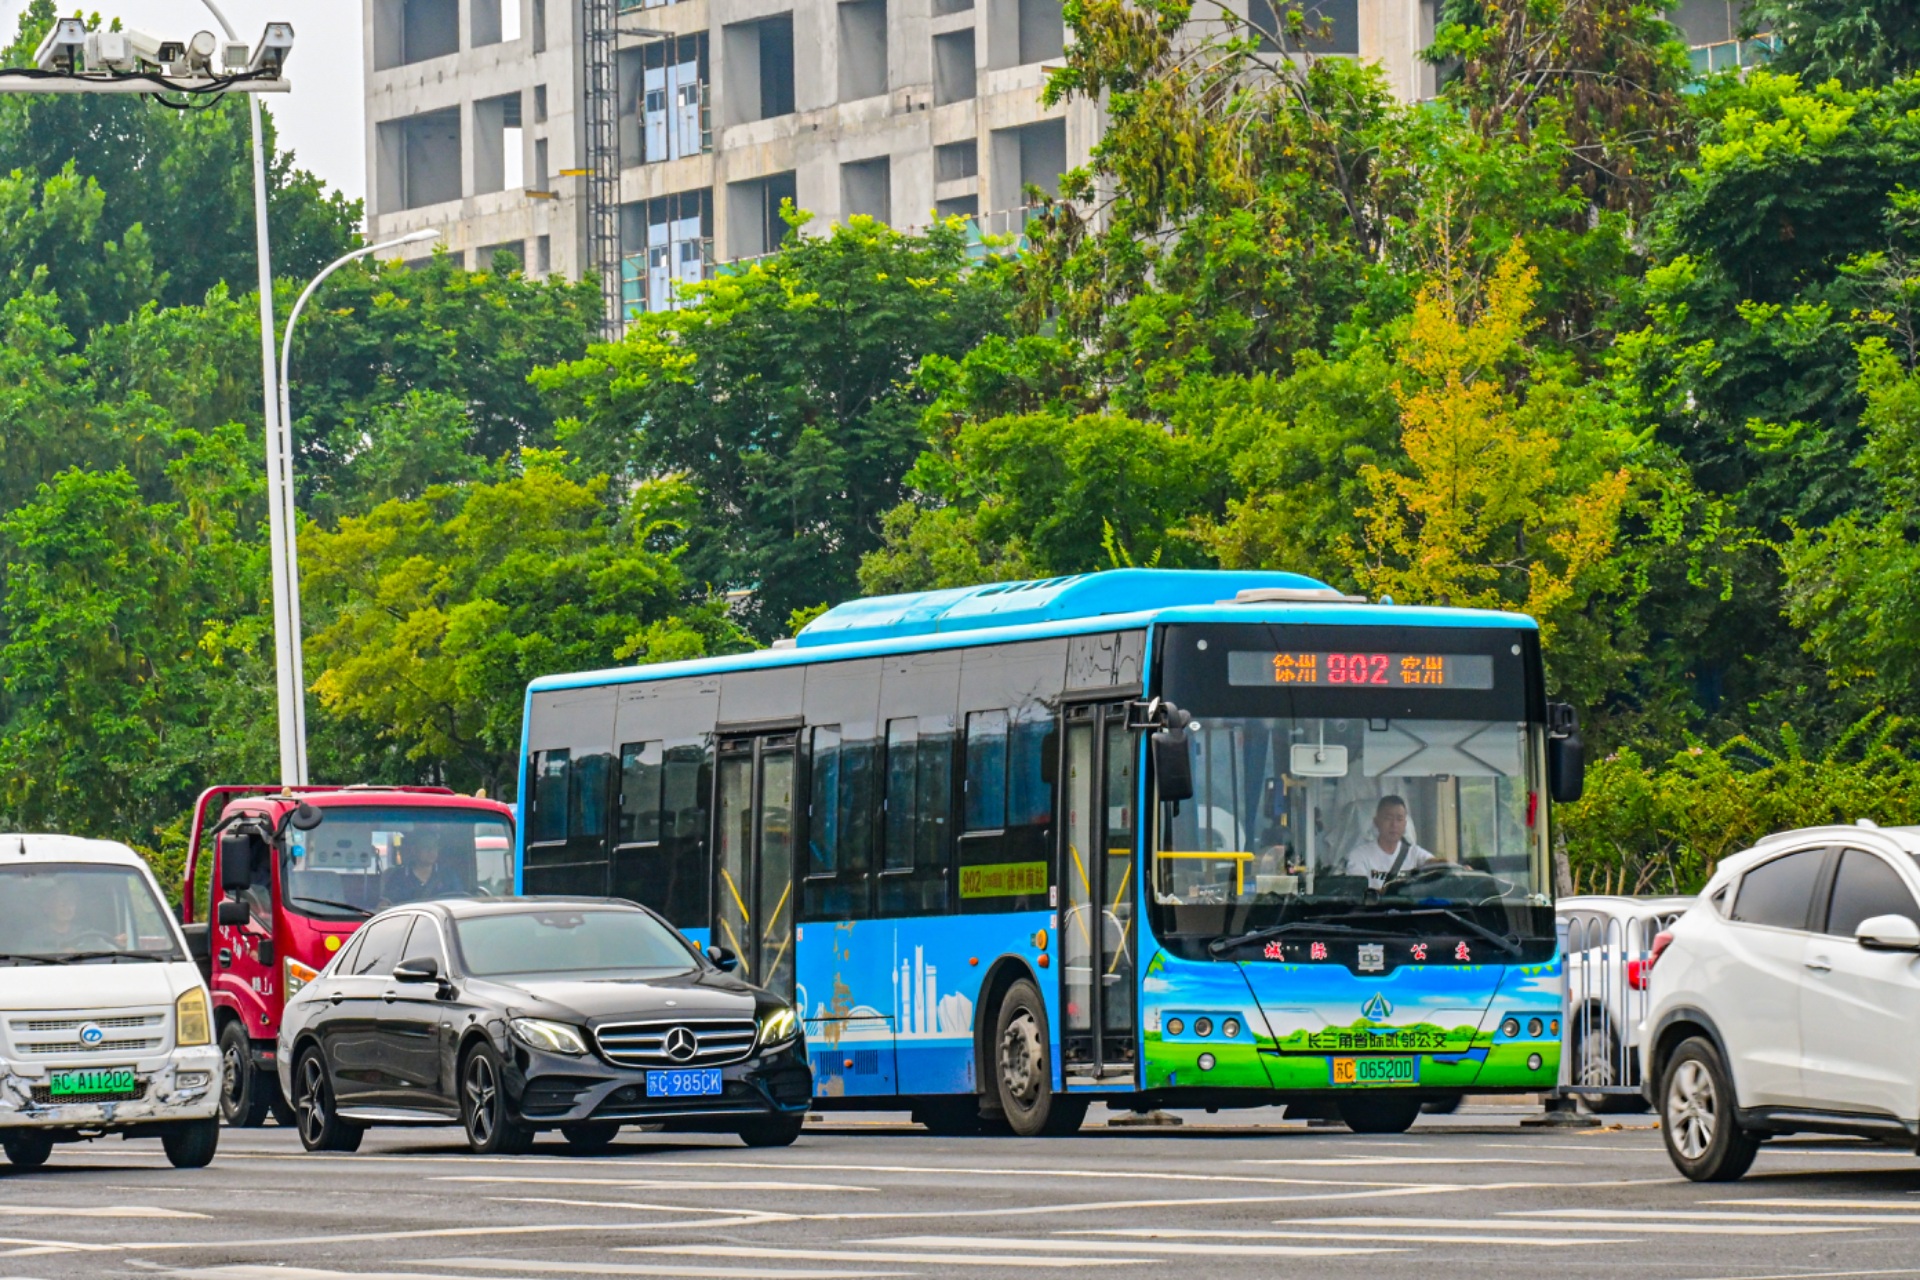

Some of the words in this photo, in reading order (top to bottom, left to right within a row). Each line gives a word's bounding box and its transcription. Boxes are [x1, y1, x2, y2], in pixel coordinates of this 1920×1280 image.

[1273, 654, 1316, 682] 徐州
[1327, 654, 1390, 684] 902
[1400, 656, 1443, 684] 宿州
[963, 870, 981, 893] 902
